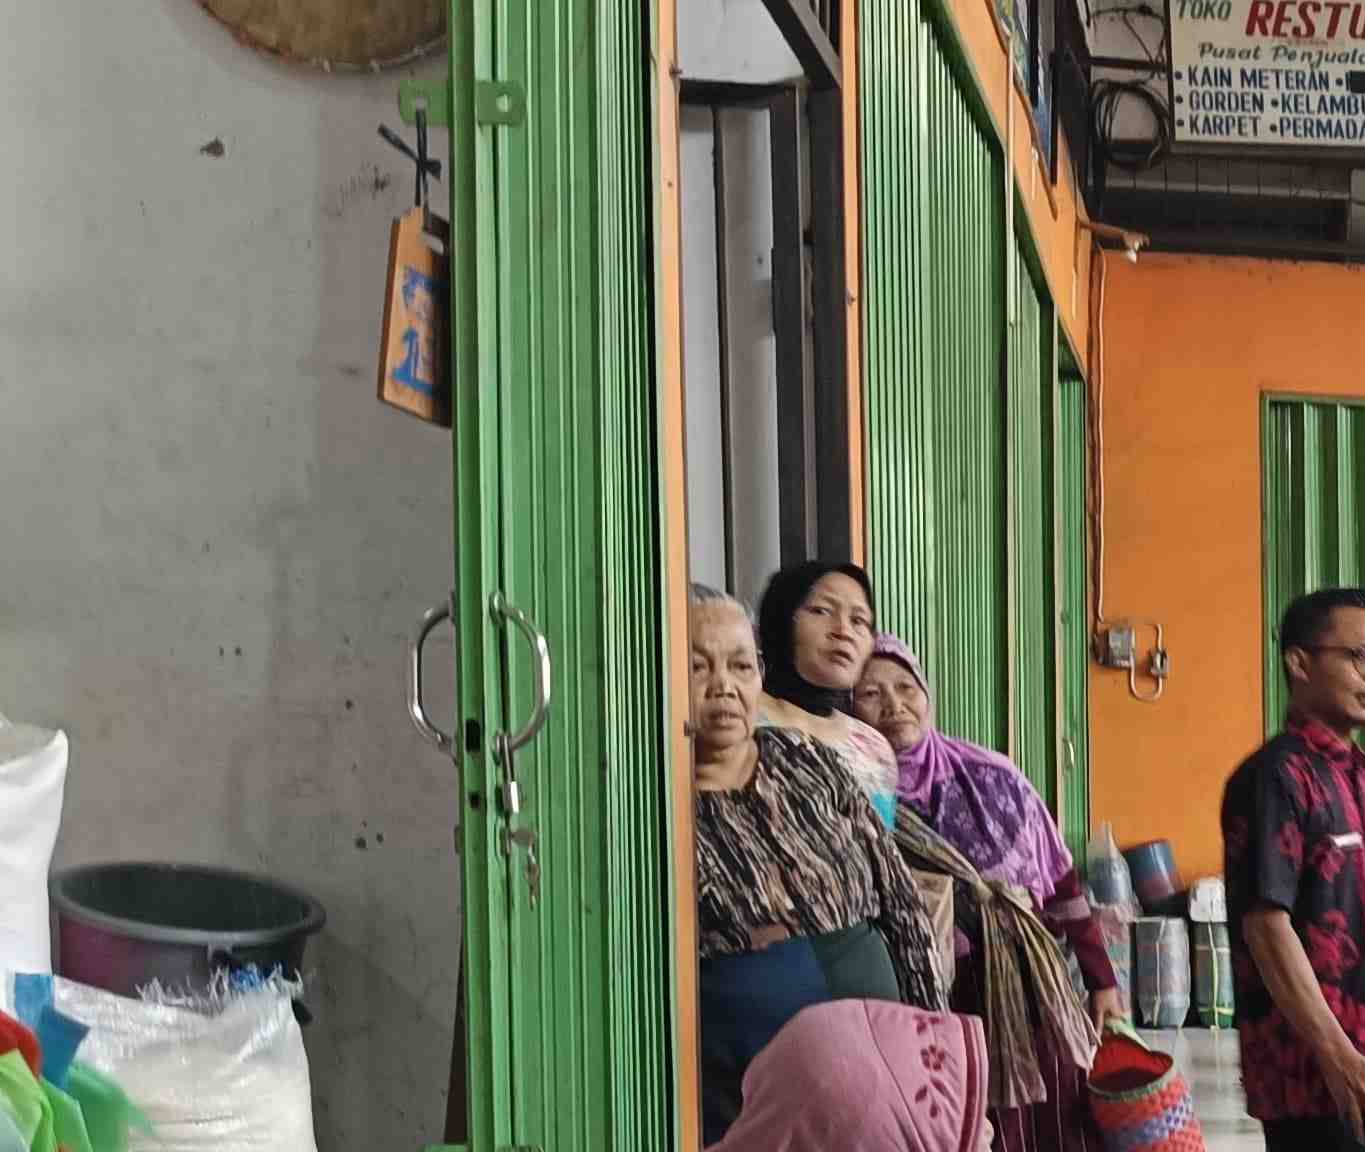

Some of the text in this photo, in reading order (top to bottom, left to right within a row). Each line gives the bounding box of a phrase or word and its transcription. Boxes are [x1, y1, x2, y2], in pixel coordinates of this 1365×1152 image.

[1178, 0, 1232, 20] TOKO
[1199, 42, 1261, 61] Pusat
[1187, 65, 1232, 89] KAIN
[1240, 67, 1330, 92] METERAN
[1189, 89, 1264, 114] GORDEN
[1188, 113, 1261, 138] KARPET
